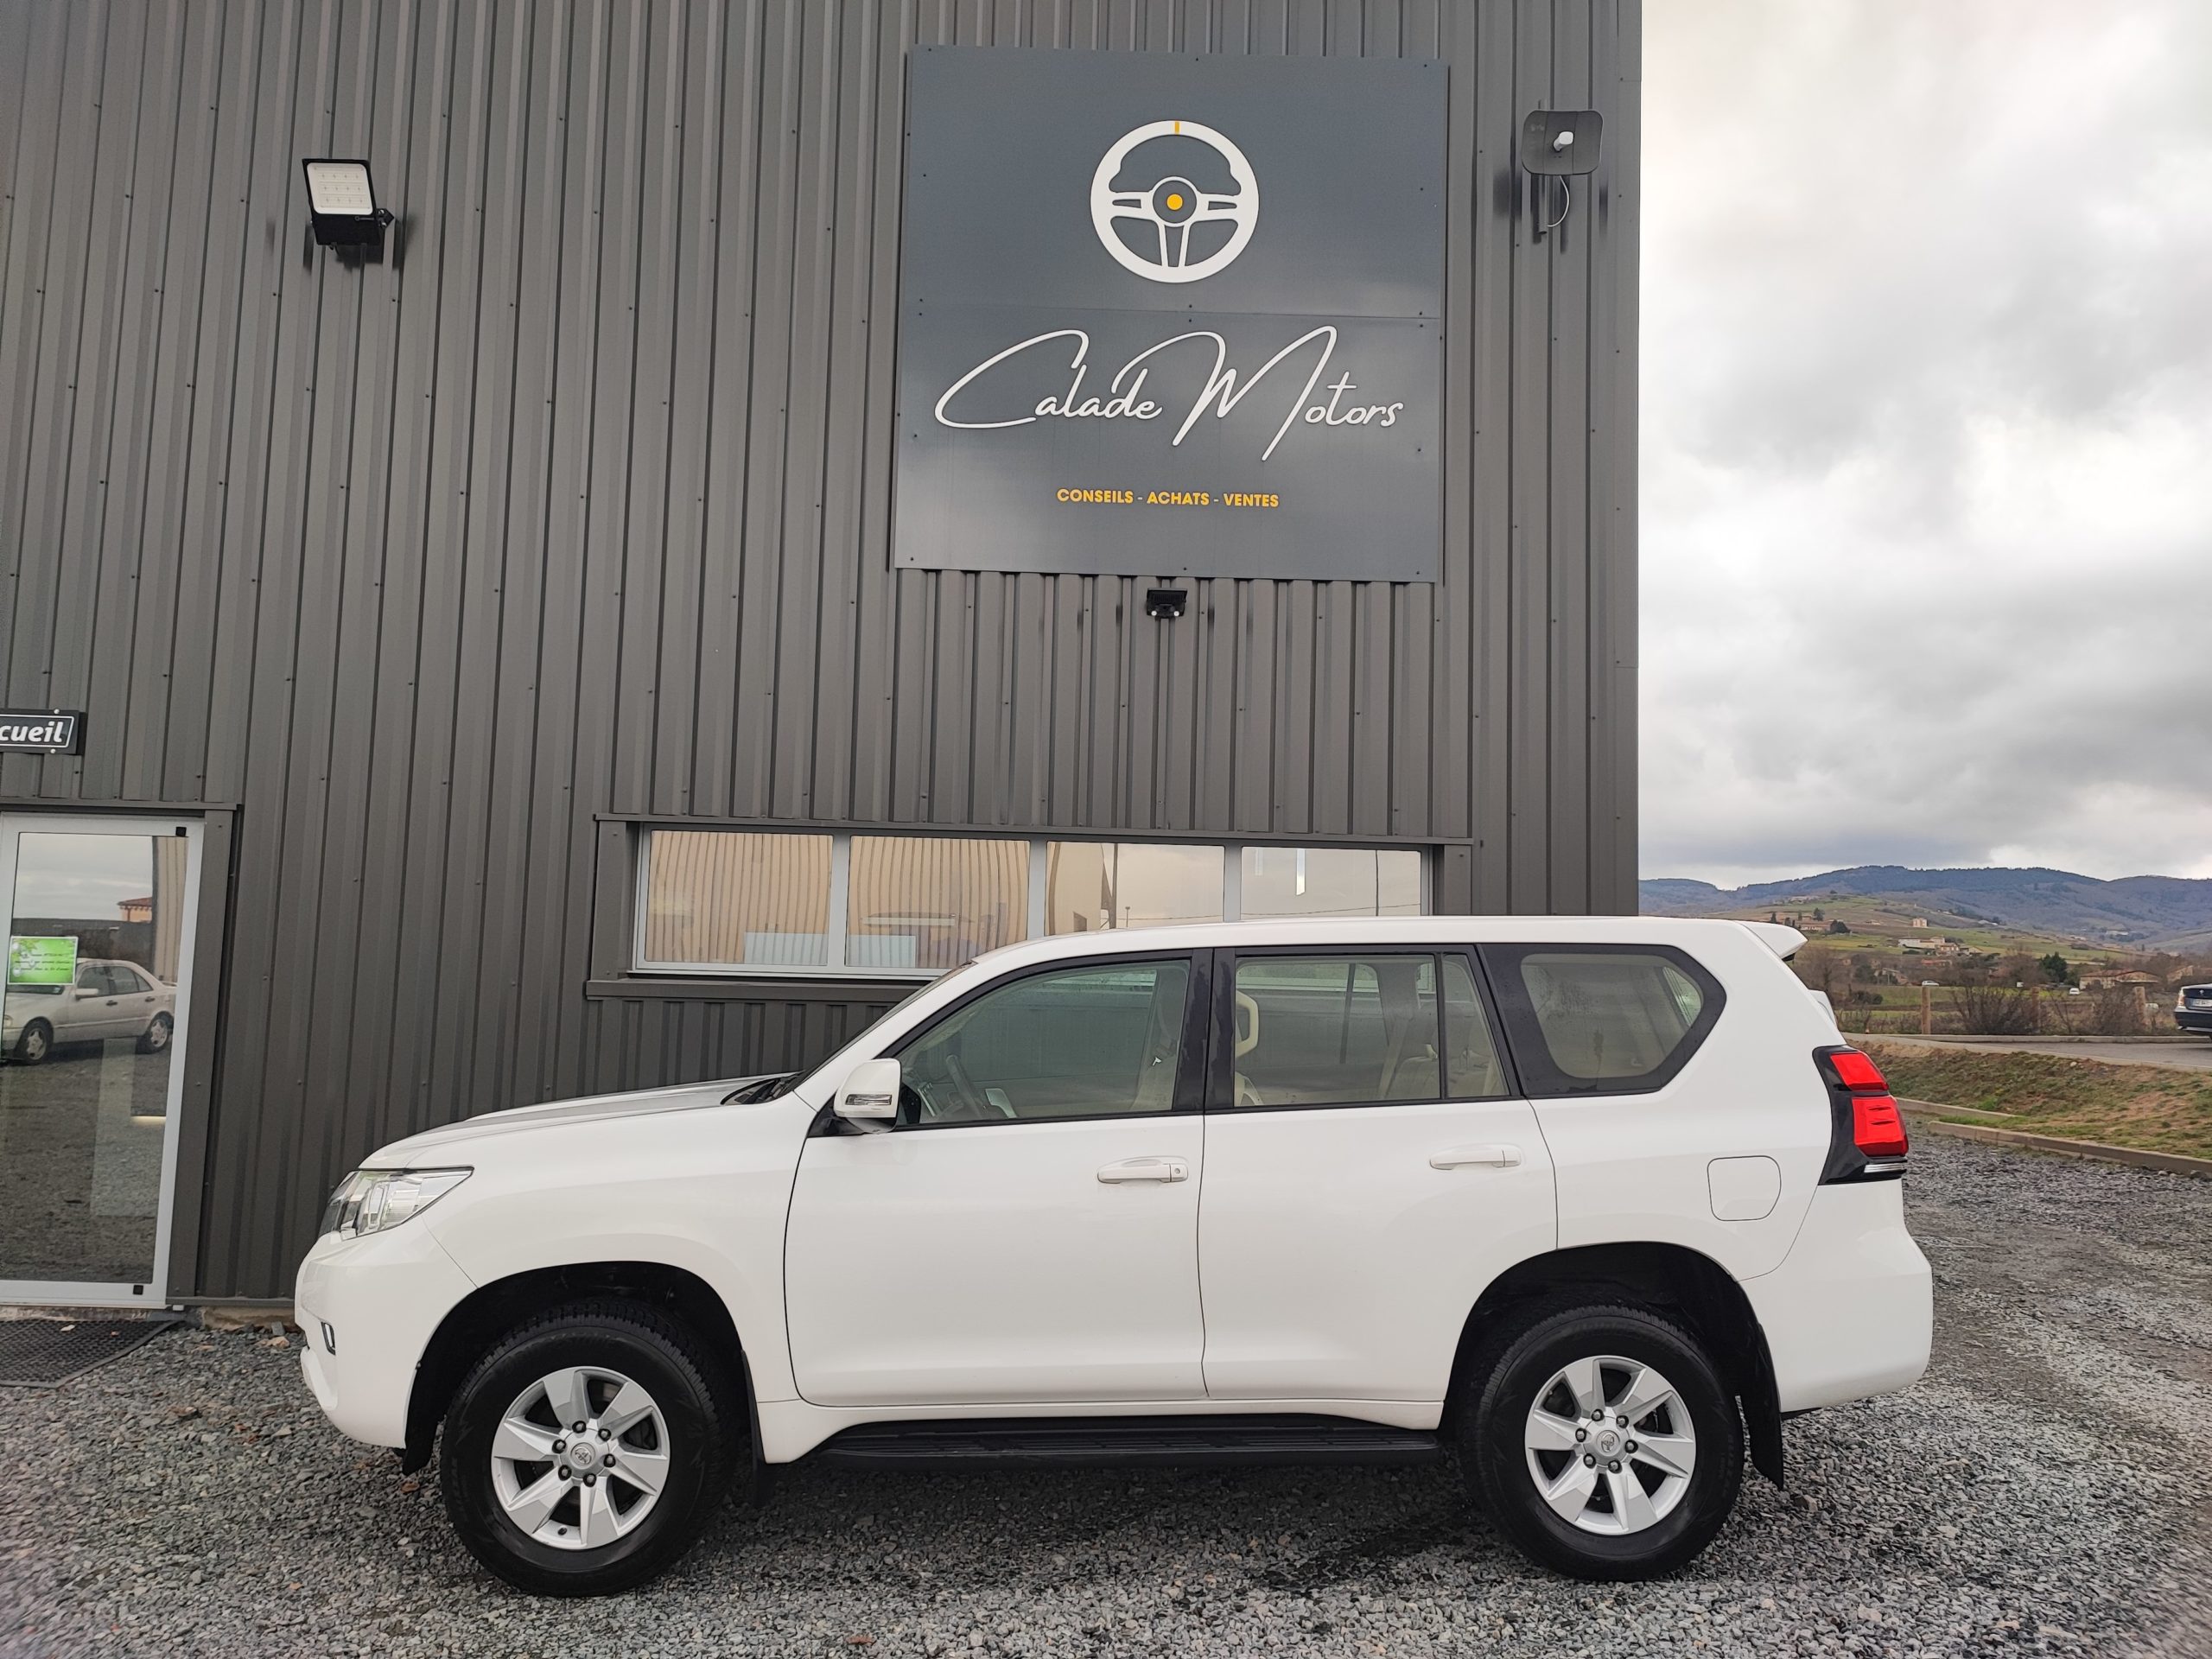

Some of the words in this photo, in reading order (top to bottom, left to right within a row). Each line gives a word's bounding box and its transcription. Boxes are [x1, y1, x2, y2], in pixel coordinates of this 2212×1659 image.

[934, 329, 1163, 429] Calade
[1111, 325, 1404, 461] Motors
[1056, 488, 1135, 505] CONSEILS
[1146, 491, 1210, 506] ACHATS
[1223, 493, 1280, 508] VENTES
